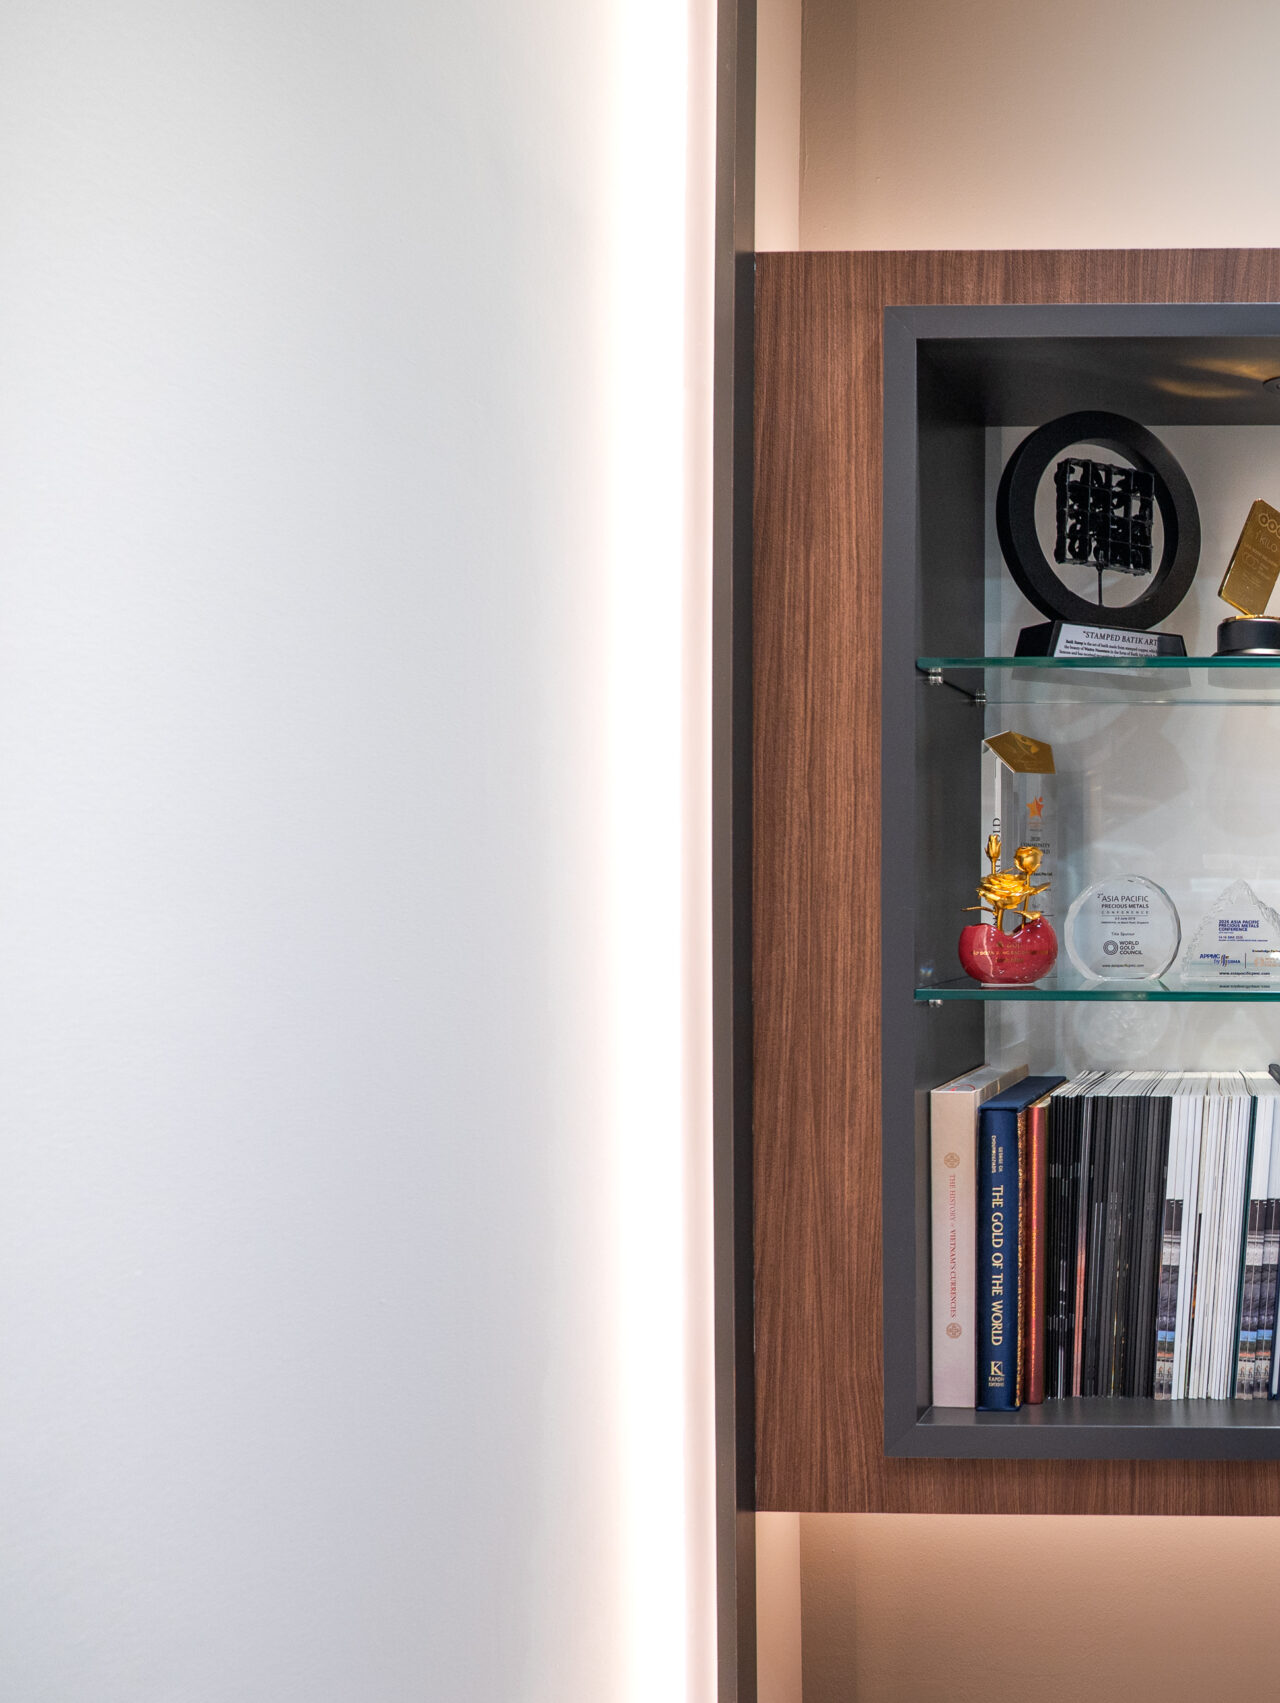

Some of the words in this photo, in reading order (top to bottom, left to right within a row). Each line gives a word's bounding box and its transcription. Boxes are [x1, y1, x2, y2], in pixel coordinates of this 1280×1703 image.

[1121, 635, 1145, 646] BATIK
[1144, 638, 1158, 647] ART
[949, 1190, 957, 1221] HISTORY
[992, 1185, 1004, 1209] THE
[992, 1212, 1004, 1248] GOLD
[992, 1252, 1004, 1269] OF
[949, 1270, 957, 1319] CURRENCIES
[992, 1273, 1004, 1296] THE
[992, 1300, 1004, 1346] WORLD
